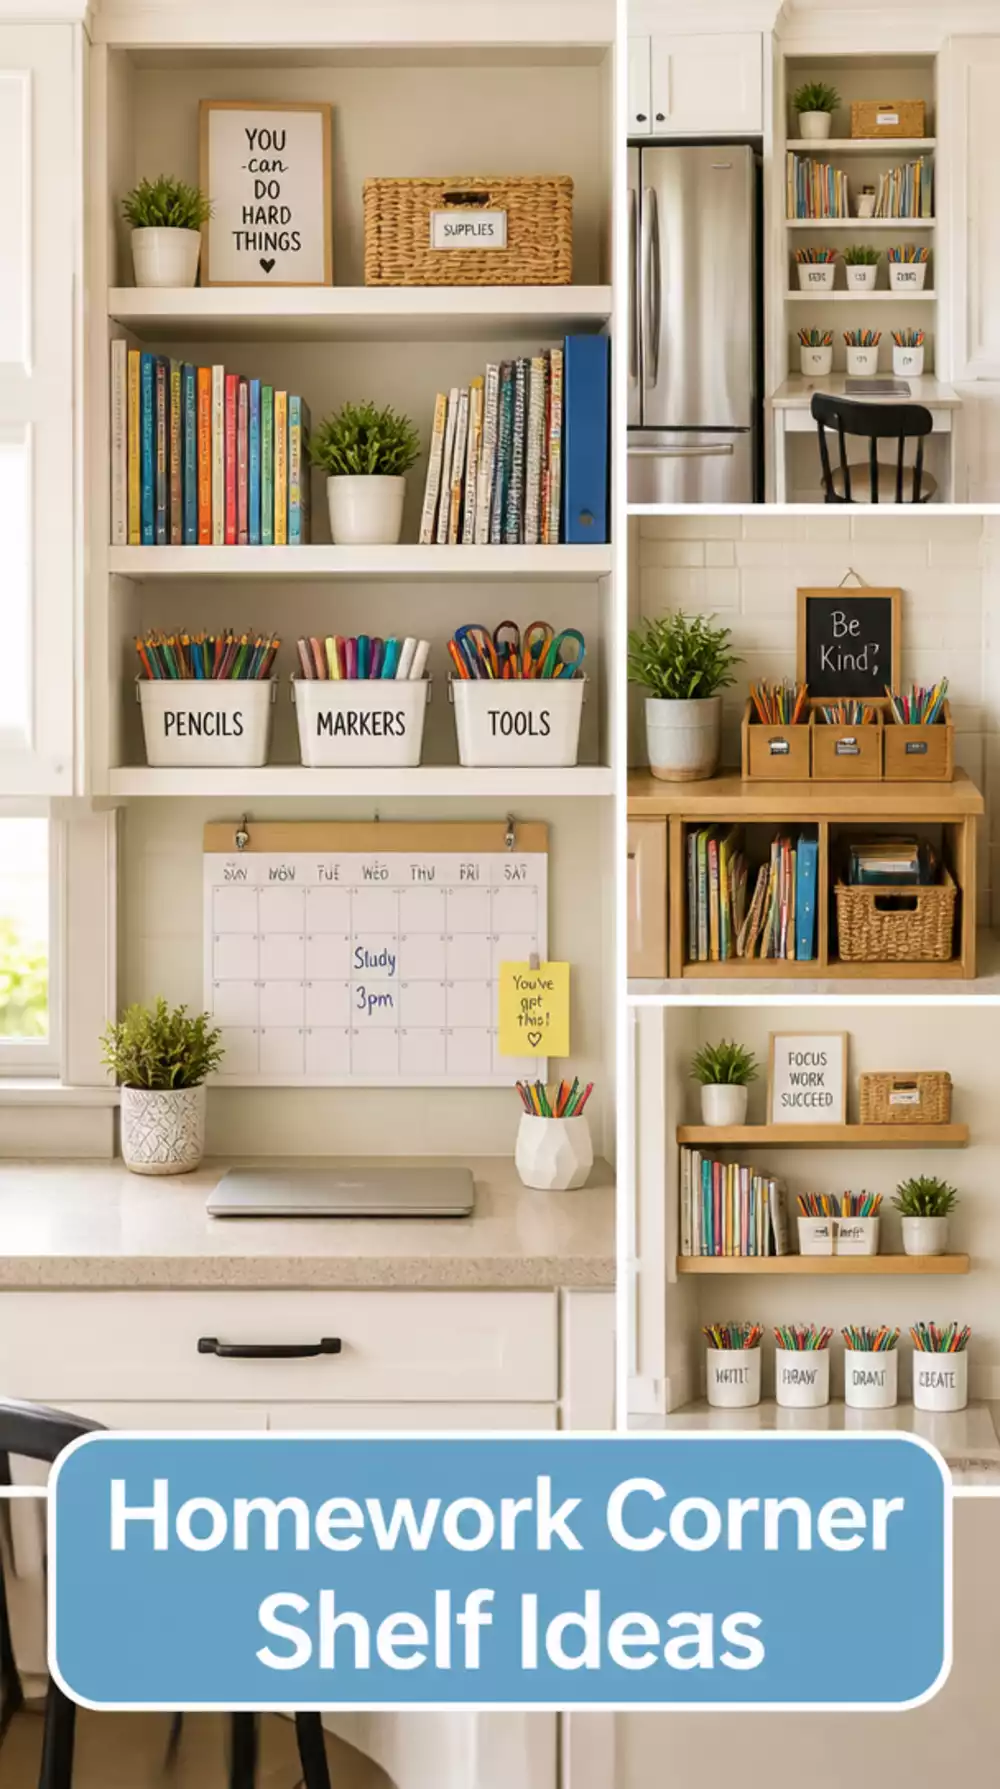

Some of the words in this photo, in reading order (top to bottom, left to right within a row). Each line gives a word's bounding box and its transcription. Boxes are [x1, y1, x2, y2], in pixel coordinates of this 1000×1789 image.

[244, 127, 286, 152] YOU
[254, 179, 281, 200] DO
[242, 205, 292, 226] HARD
[232, 230, 302, 252] THINGS
[443, 223, 495, 237] SUPPLIES
[829, 610, 861, 638] Be
[163, 711, 244, 737] PENCILS
[316, 711, 406, 737] MARKERS
[487, 711, 551, 737] TOOLS
[356, 985, 394, 1016] 3pm
[787, 1051, 828, 1068] FOCUS
[788, 1070, 826, 1088] WORK
[780, 1090, 834, 1109] SUCCEED
